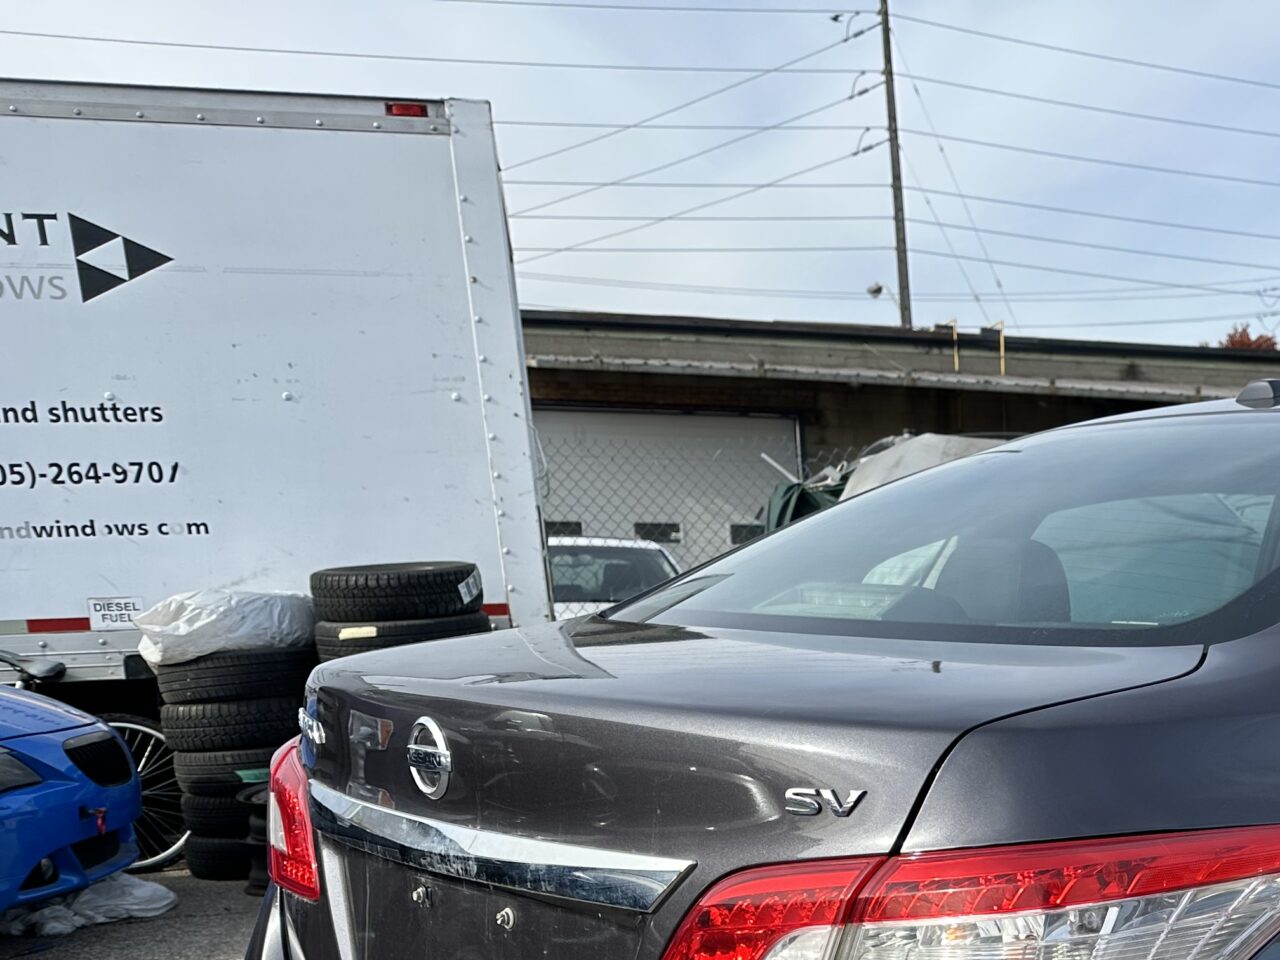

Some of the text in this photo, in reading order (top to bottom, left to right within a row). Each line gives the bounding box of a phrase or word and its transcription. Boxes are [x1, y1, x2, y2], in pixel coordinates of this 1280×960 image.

[0, 400, 163, 423] nd shutters
[93, 602, 141, 612] DIESEL
[101, 613, 134, 623] FUEL
[784, 787, 868, 817] SV
